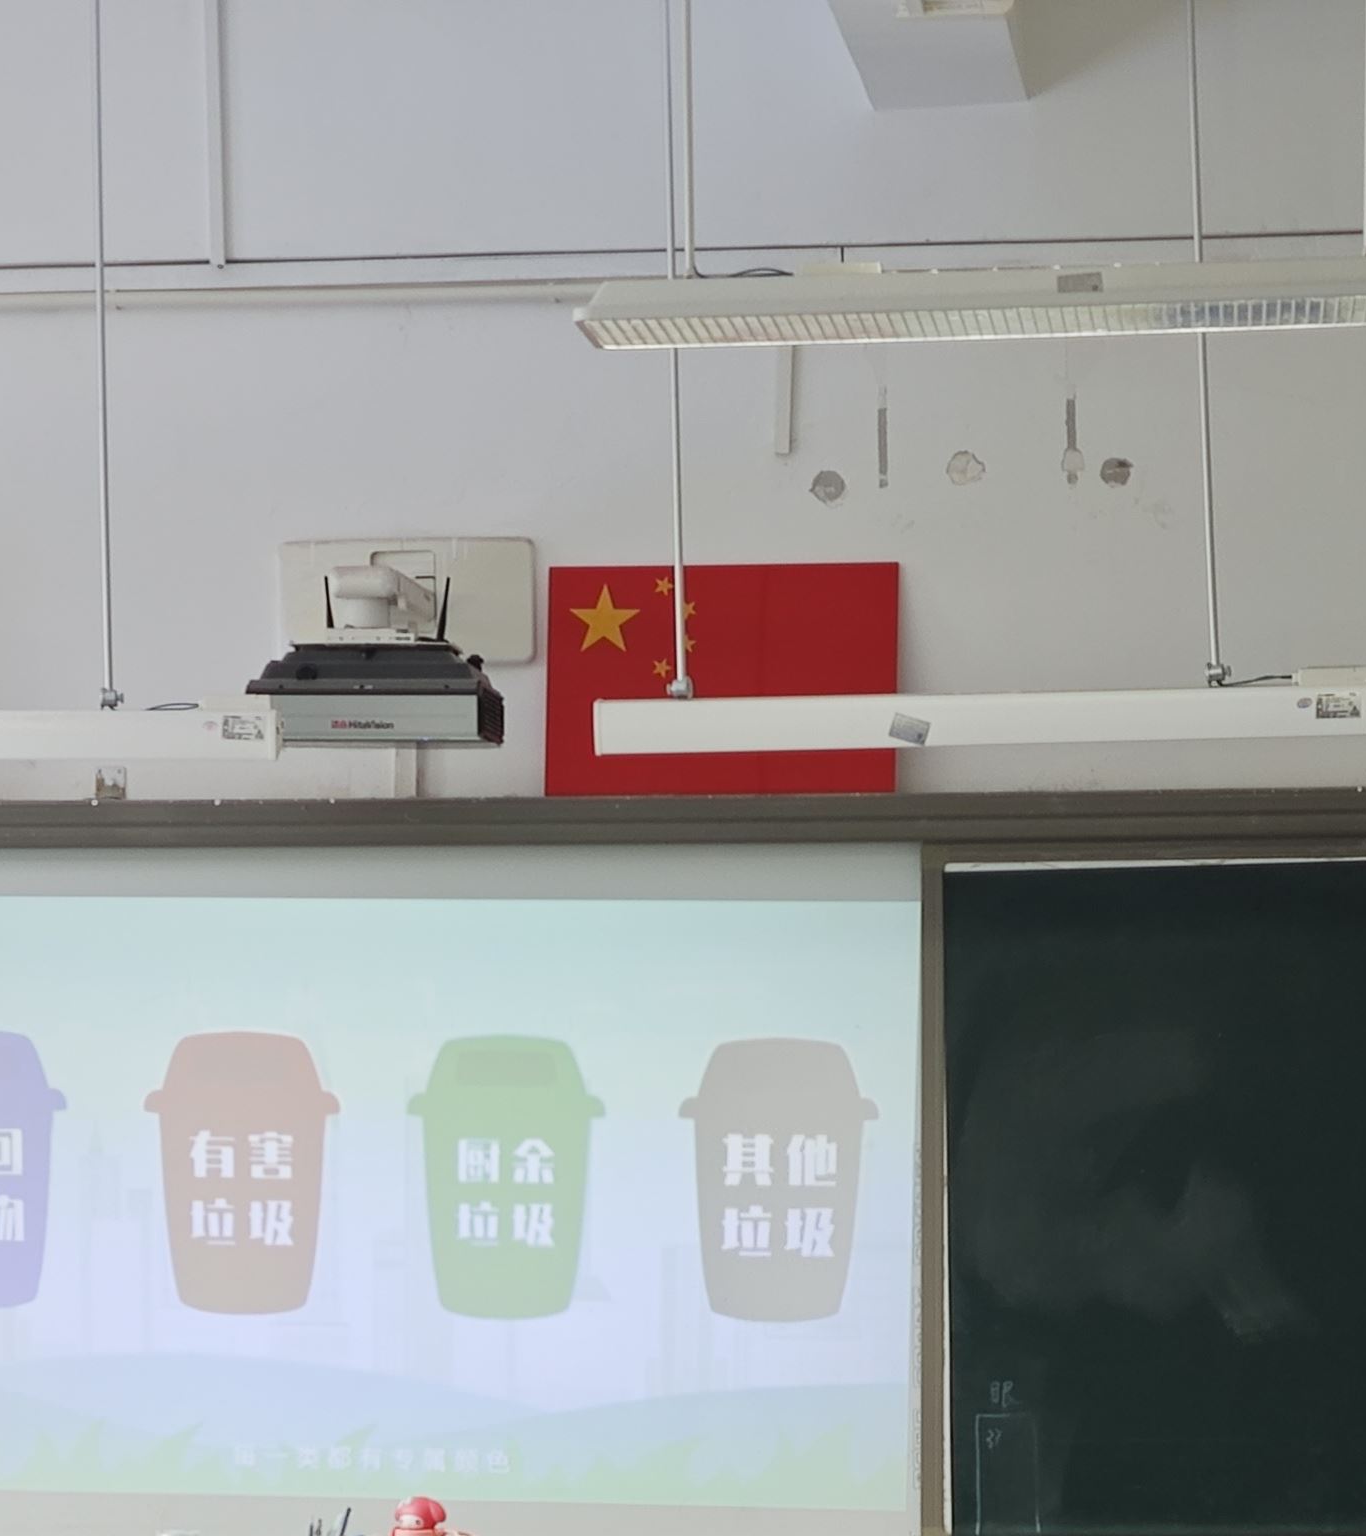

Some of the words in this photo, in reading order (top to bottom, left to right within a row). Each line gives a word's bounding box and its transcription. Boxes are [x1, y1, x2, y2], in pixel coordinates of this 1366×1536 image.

[189, 1131, 295, 1181] 有害
[457, 1137, 556, 1186] 厨余
[722, 1134, 837, 1188] 其他
[190, 1198, 295, 1247] 垃圾
[456, 1202, 555, 1248] 垃圾
[720, 1206, 835, 1258] 垃圾
